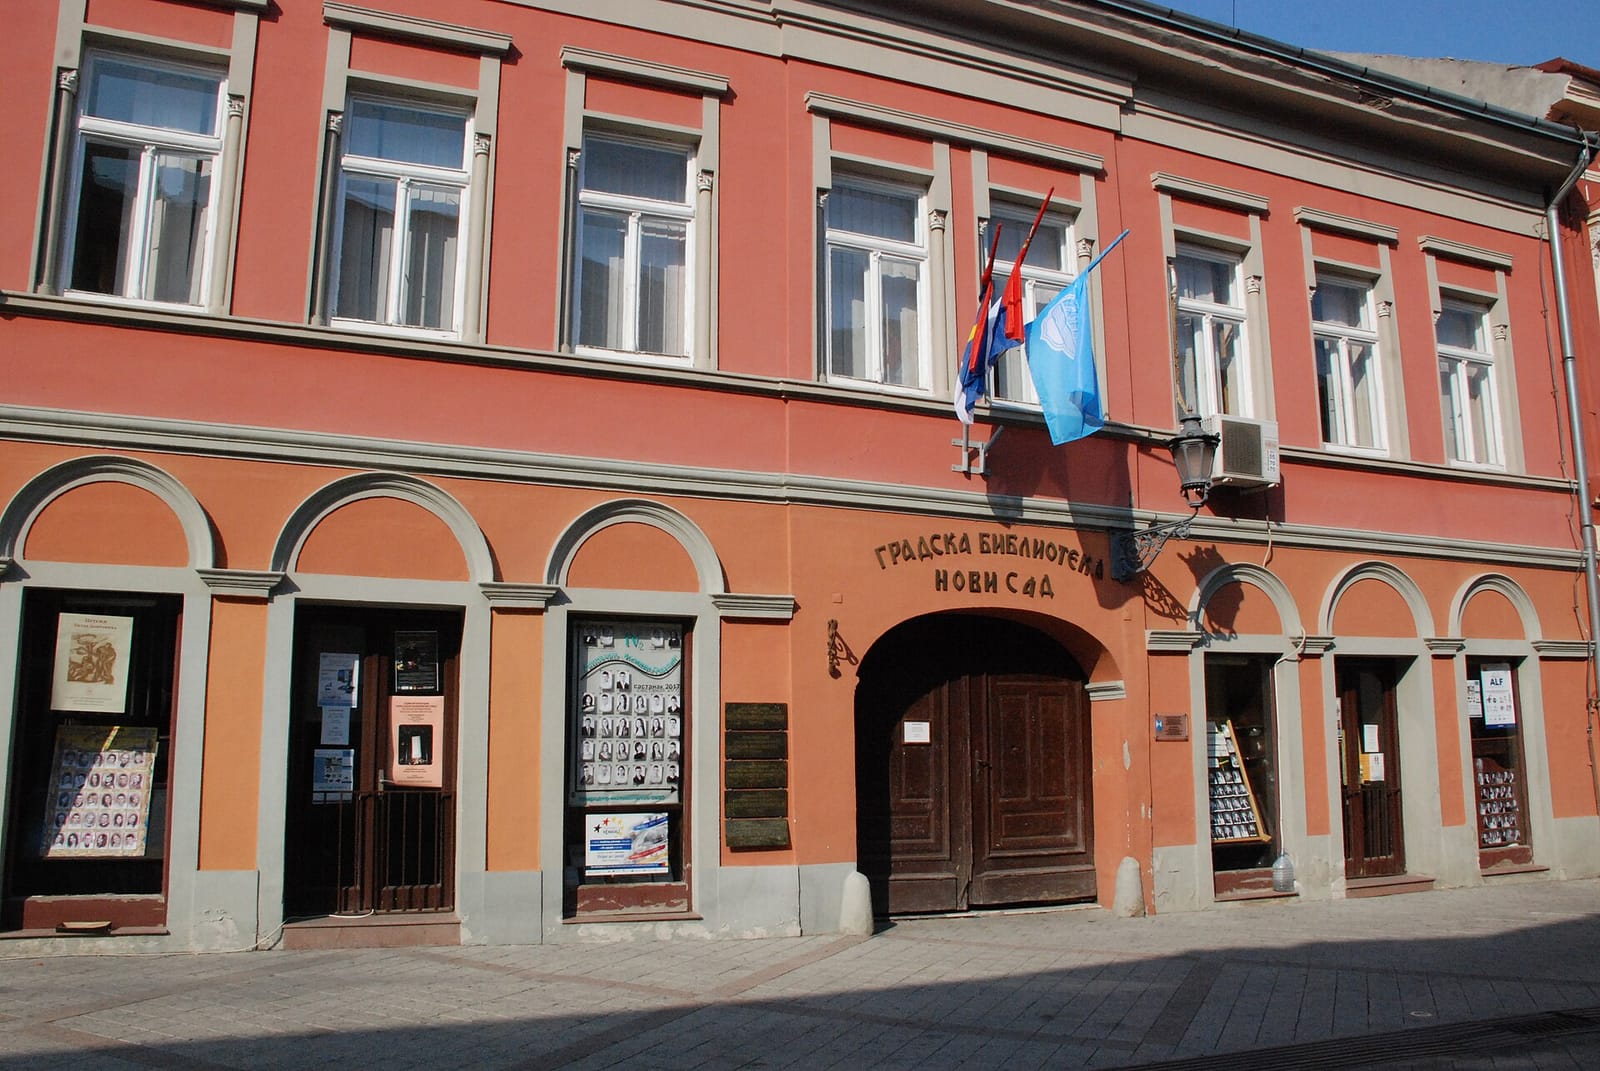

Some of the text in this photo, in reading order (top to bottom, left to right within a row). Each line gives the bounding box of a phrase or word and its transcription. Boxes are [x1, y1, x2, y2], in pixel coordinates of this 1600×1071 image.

[874, 532, 1104, 580] ГРАДСКА БИБЛИОТЕКА
[934, 568, 998, 594] НОВИ
[1490, 678, 1504, 686] ALF
